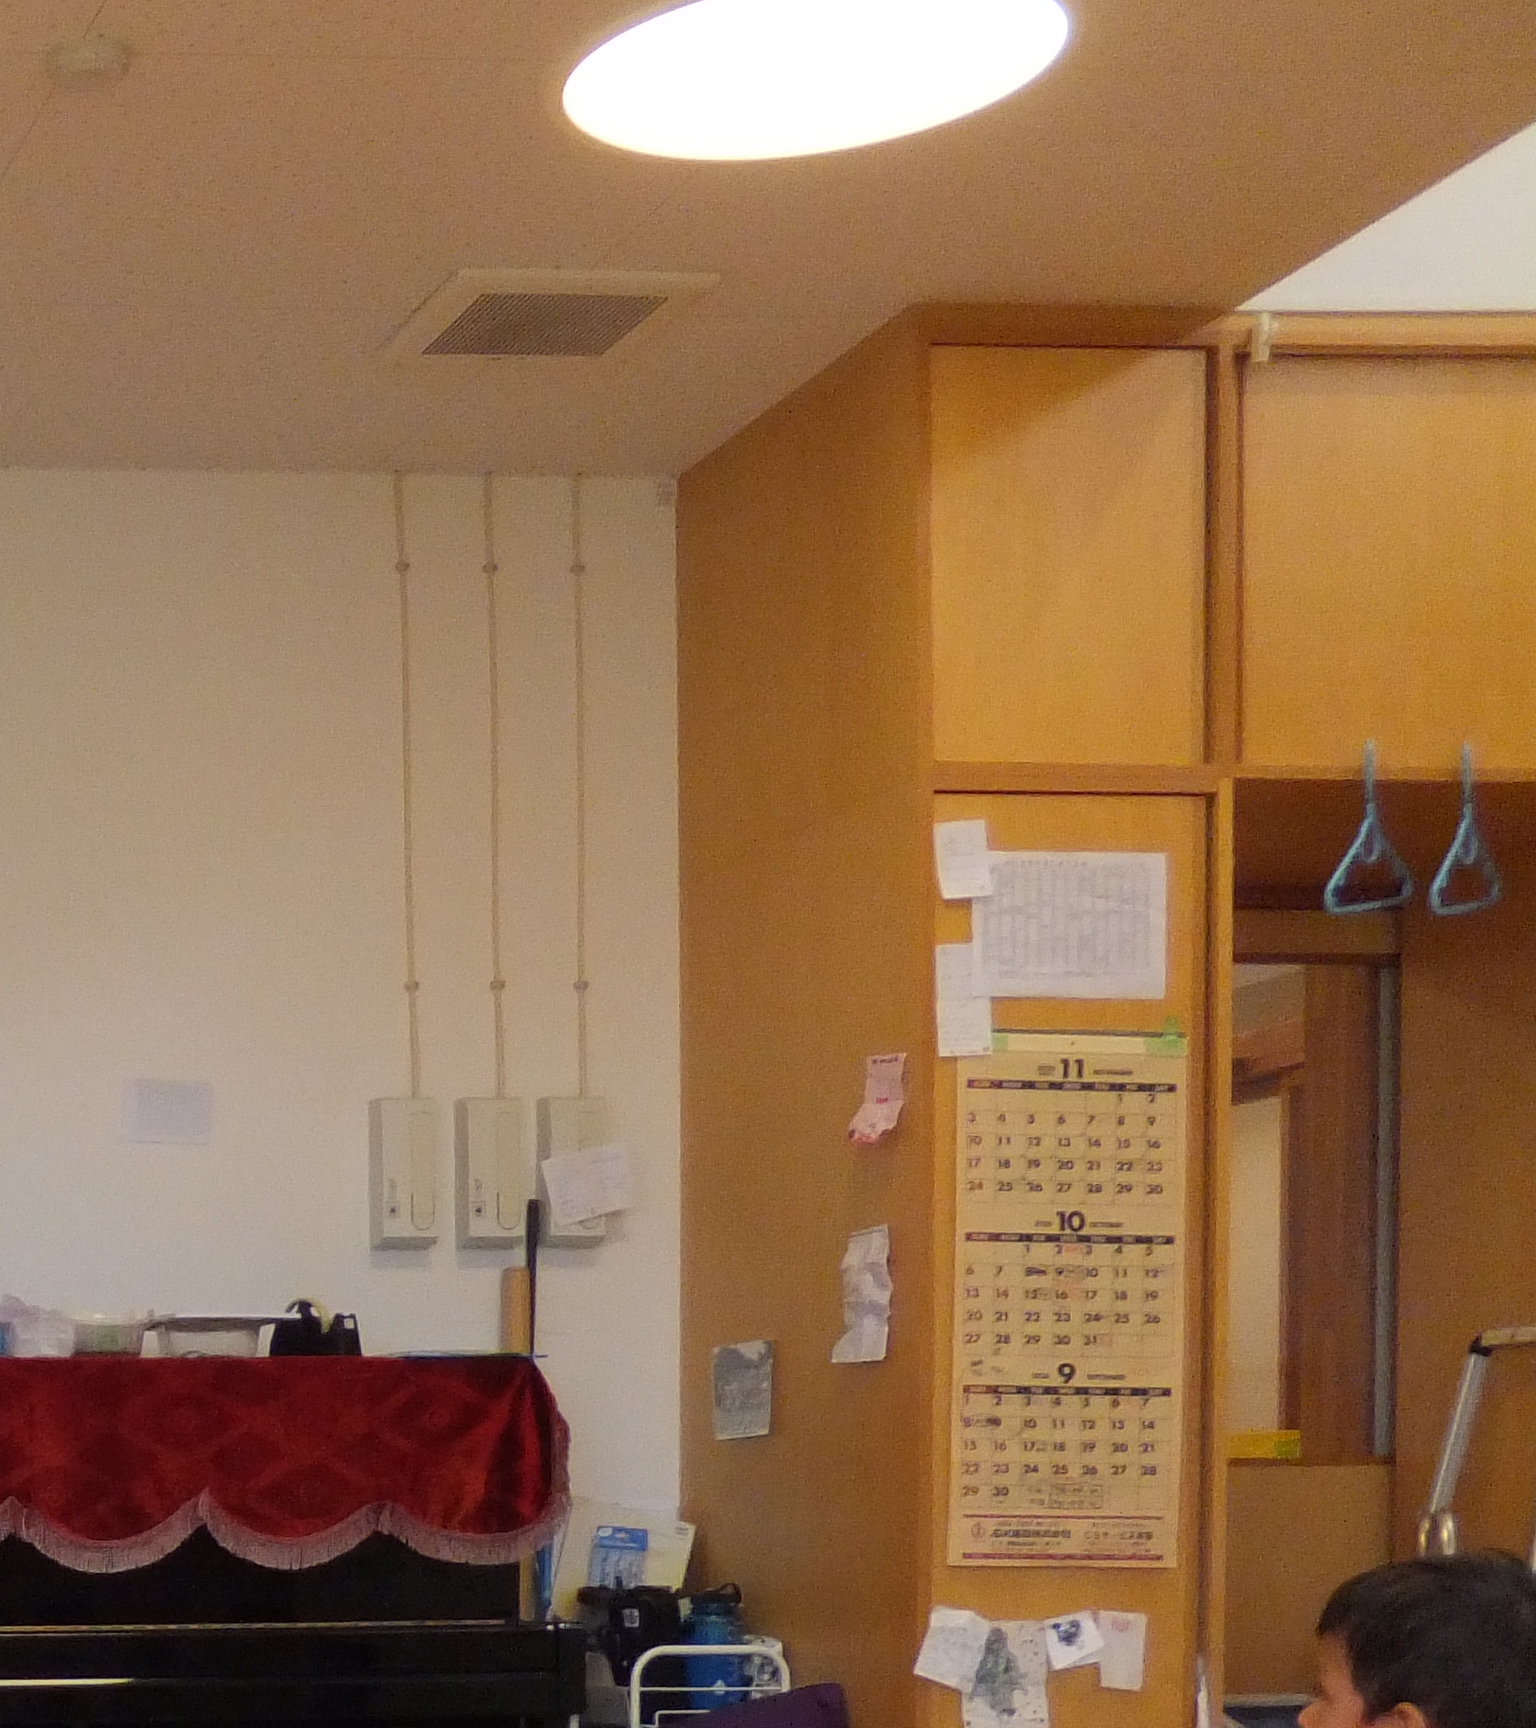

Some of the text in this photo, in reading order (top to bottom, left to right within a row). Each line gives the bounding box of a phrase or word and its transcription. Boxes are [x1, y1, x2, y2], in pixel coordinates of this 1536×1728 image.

[1061, 1058, 1084, 1079] 11
[1057, 1211, 1085, 1232] 10
[1057, 1363, 1077, 1384] 9
